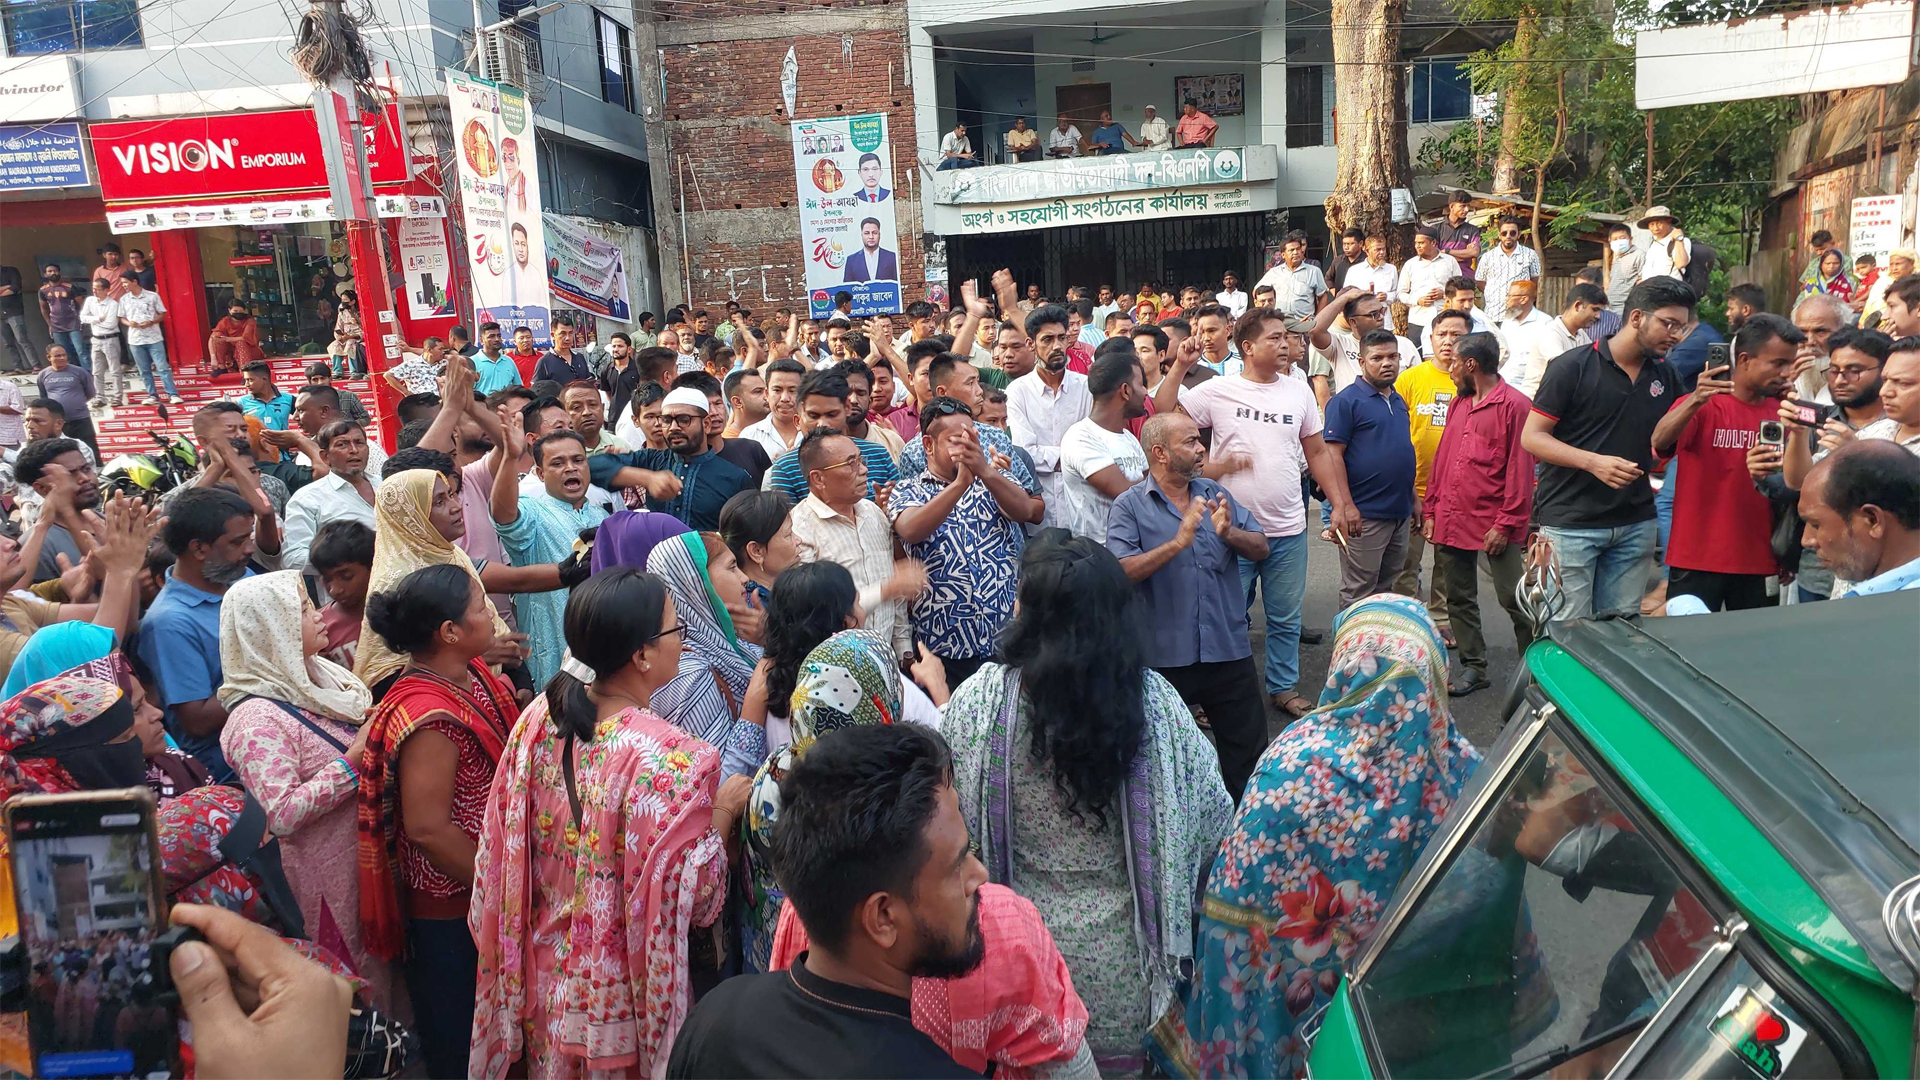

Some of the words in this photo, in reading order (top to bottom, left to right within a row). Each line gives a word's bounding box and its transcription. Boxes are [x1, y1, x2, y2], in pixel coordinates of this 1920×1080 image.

[240, 152, 306, 169] EMPORIUM
[981, 168, 1040, 197] বাংলাদেশ
[962, 209, 994, 228] অংগ
[997, 214, 1004, 224] ও
[1007, 198, 1069, 226] সহযোগী
[1072, 195, 1145, 219] সংগঠনের
[1148, 189, 1208, 213] কার্যালয়
[1236, 408, 1294, 424] NIKE
[1713, 429, 1760, 449] HILFI
[1735, 996, 1762, 1028] I
